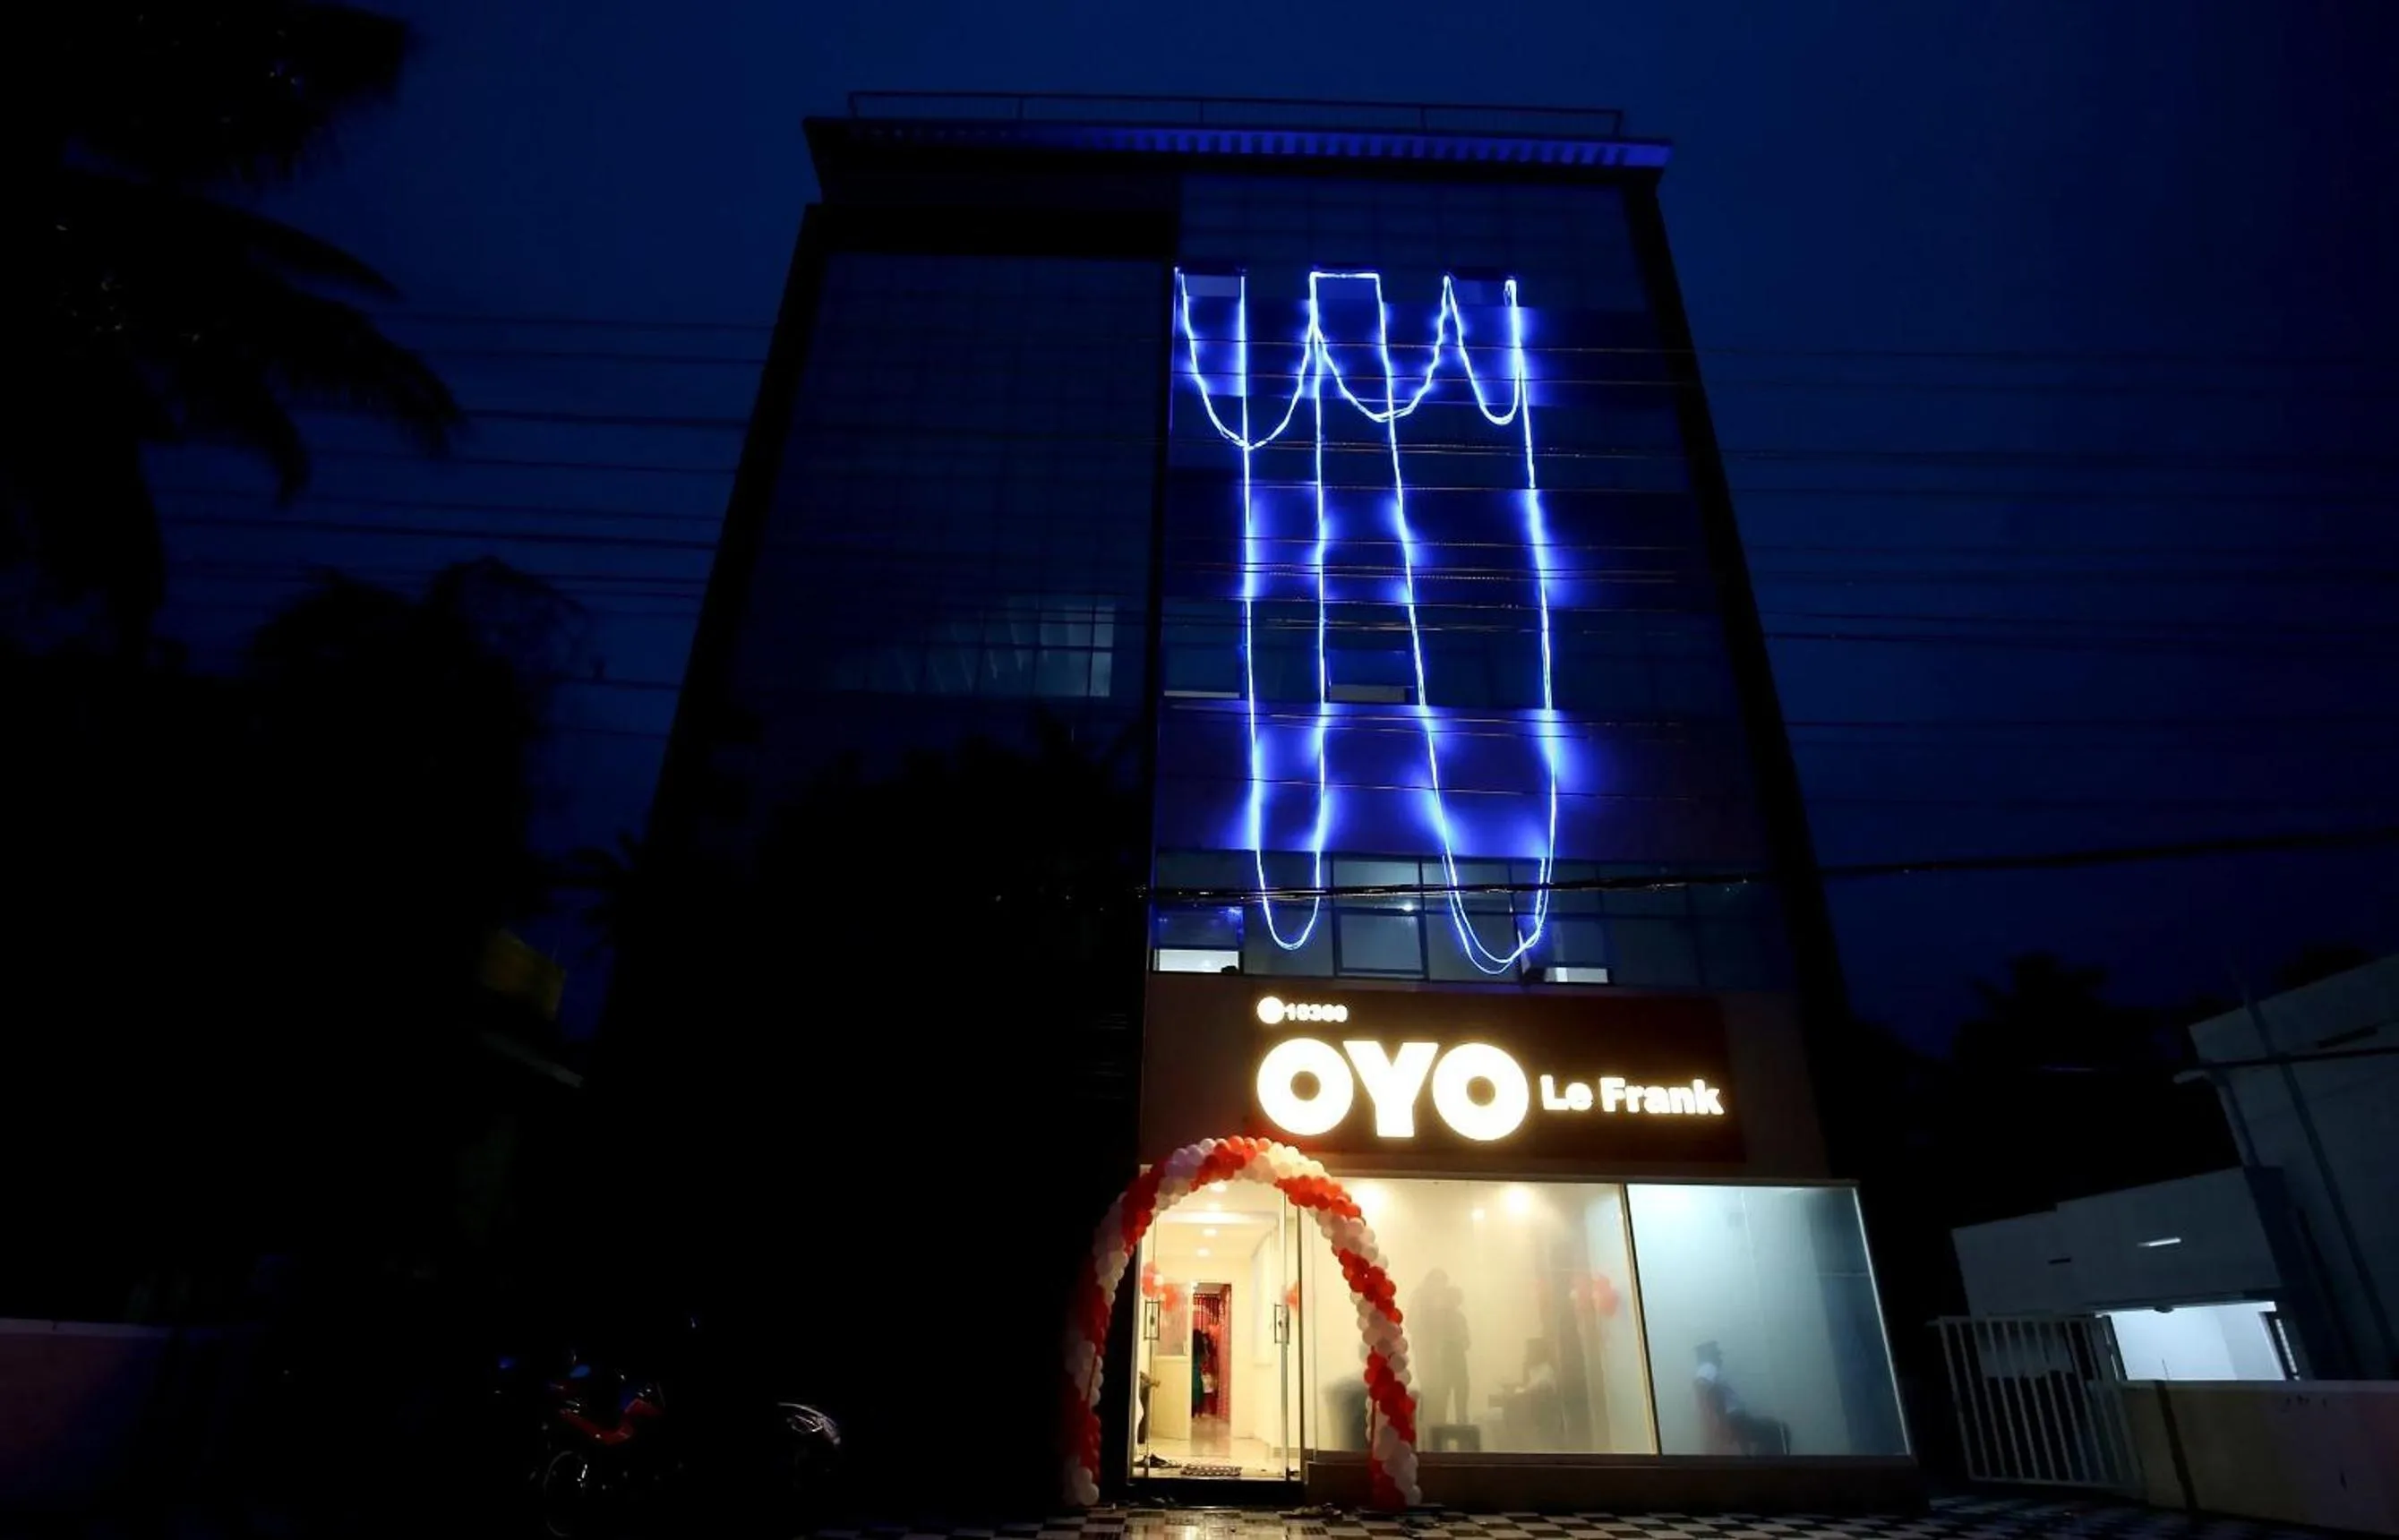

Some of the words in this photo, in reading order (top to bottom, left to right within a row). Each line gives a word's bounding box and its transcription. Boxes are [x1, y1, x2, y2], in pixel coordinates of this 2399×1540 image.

[1256, 1037, 1530, 1142] OYO
[1539, 1074, 1593, 1111] Le
[1598, 1076, 1725, 1116] Frank
